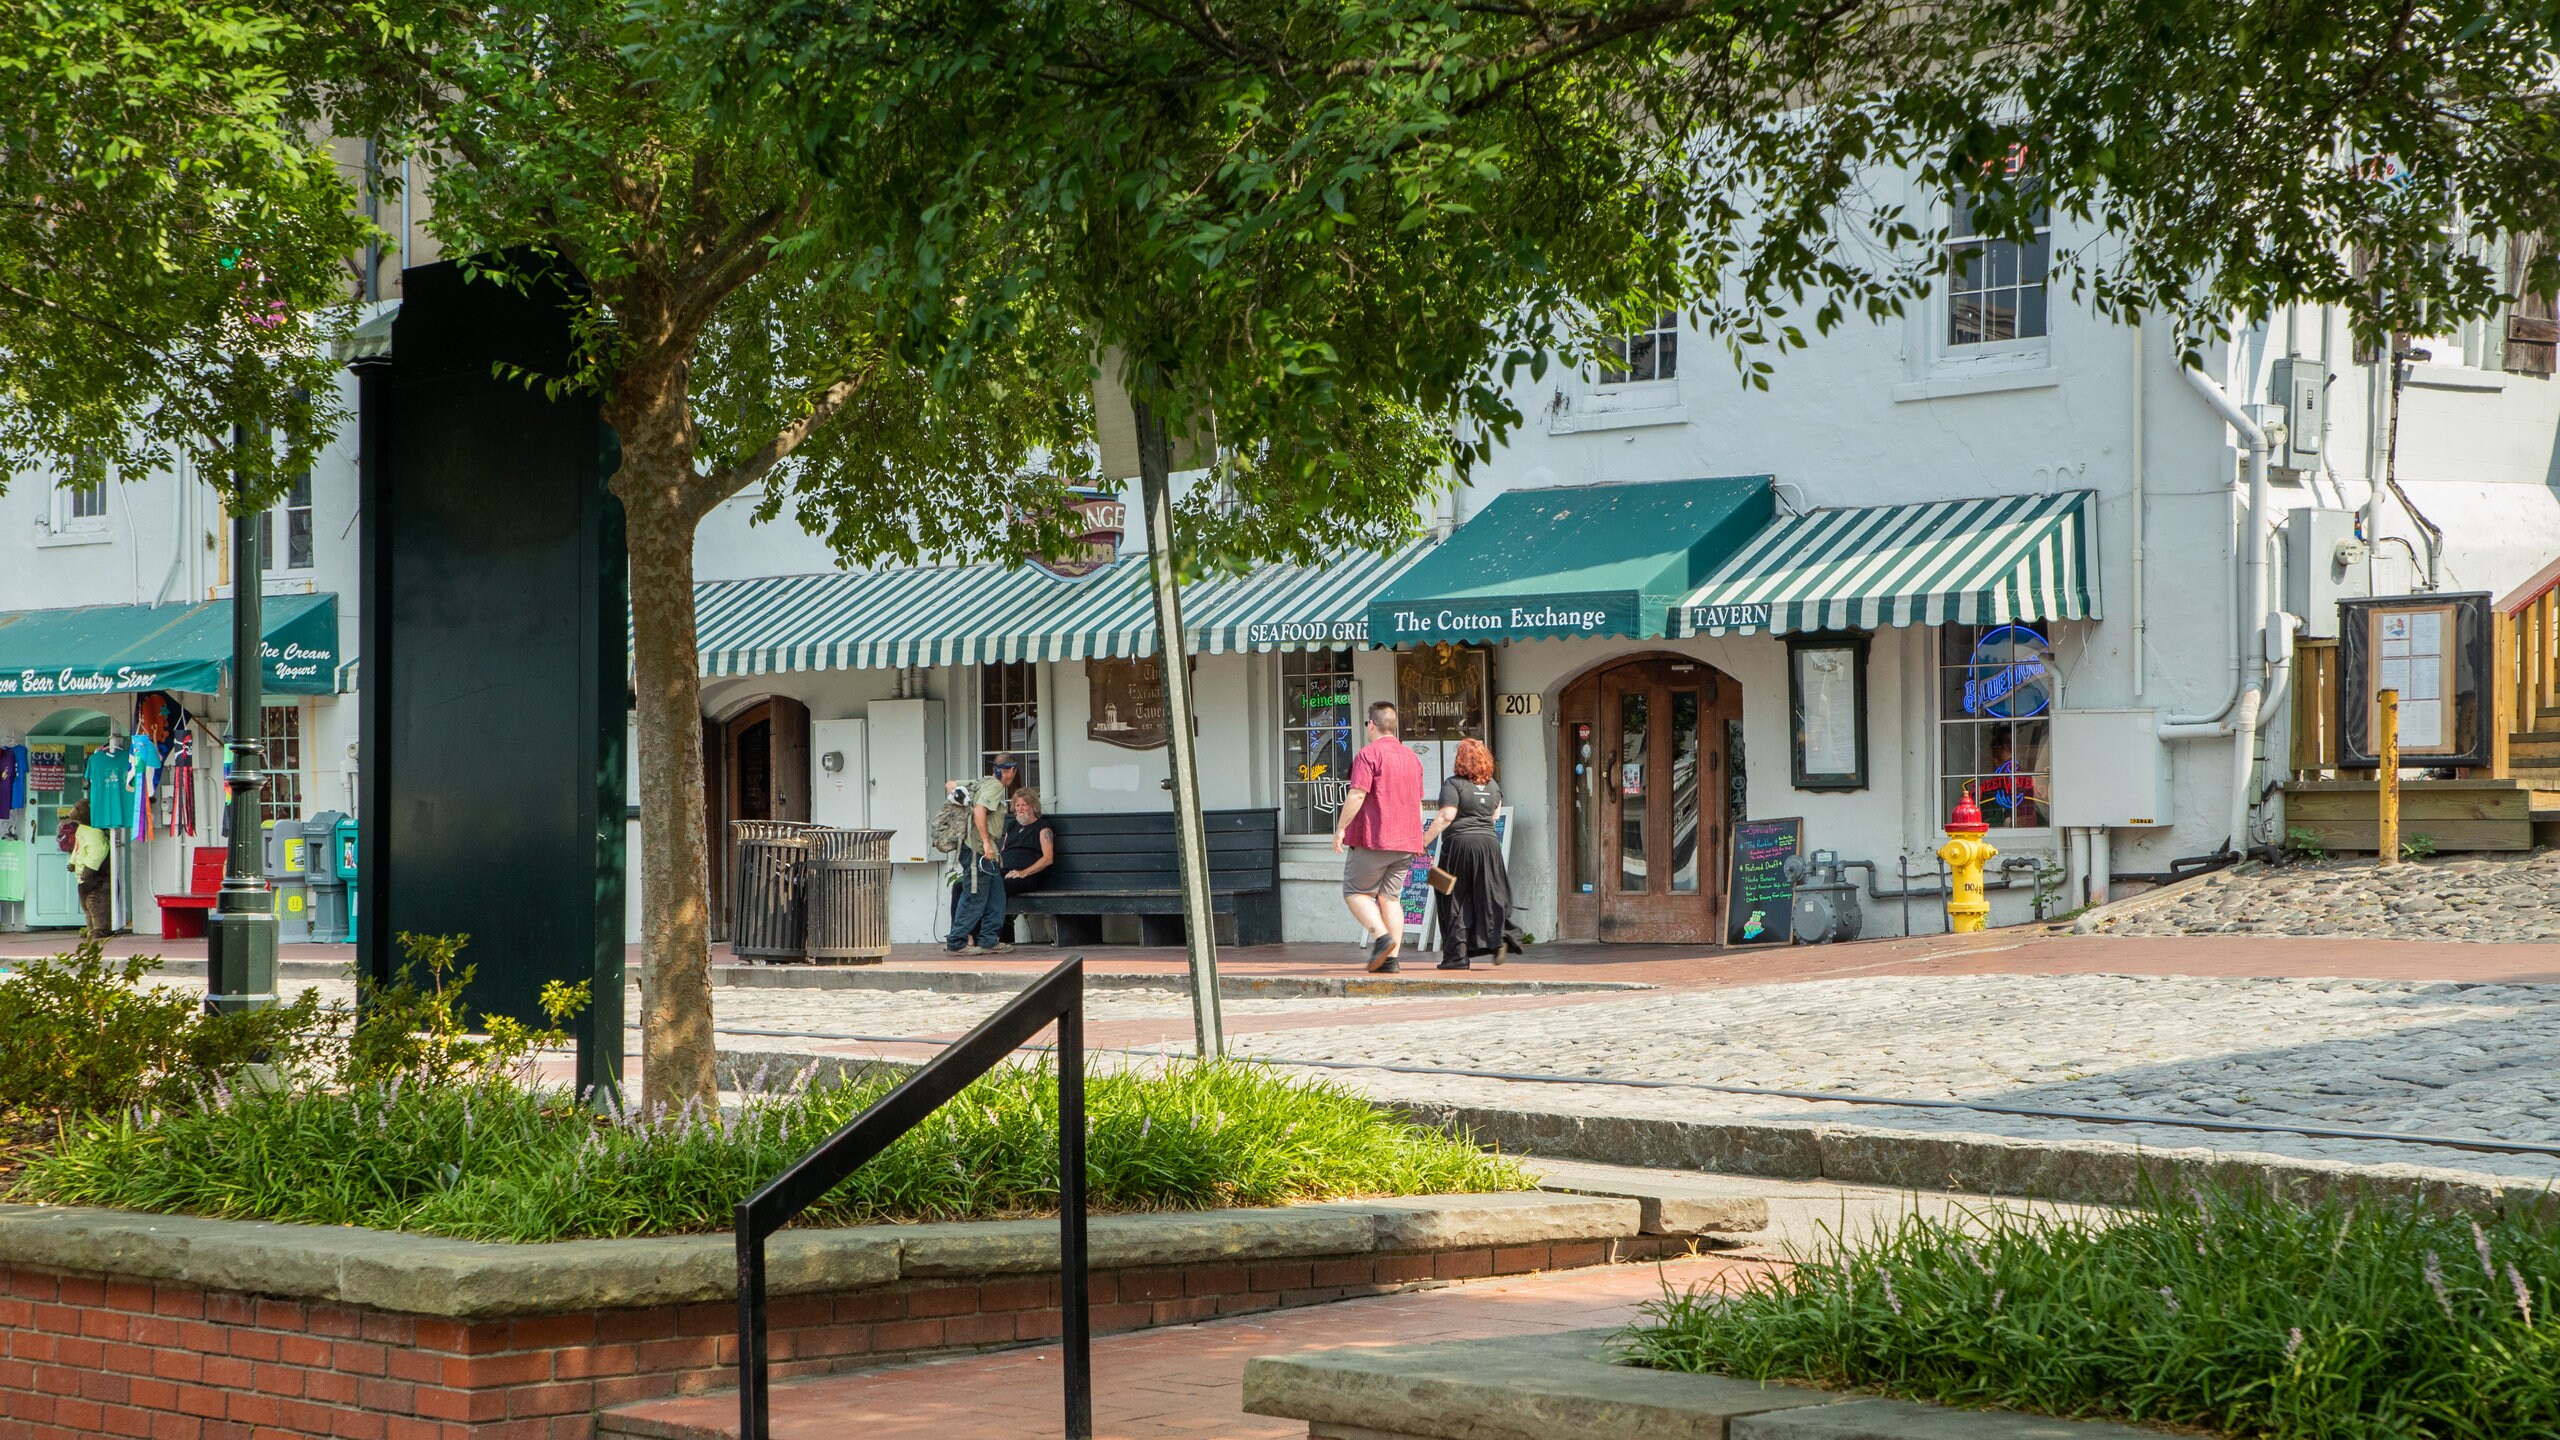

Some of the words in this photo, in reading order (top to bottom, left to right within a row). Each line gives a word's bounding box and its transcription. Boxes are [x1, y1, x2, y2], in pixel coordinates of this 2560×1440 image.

[1394, 612, 1431, 631] The
[1437, 610, 1502, 630] Cotton
[1510, 606, 1606, 630] Exchange
[1694, 604, 1768, 626] TAVERN
[1250, 622, 1327, 641] SEAFOOD
[260, 642, 279, 657] Ice
[283, 643, 331, 660] Cream
[275, 662, 317, 680] Yogurt
[1143, 664, 1161, 680] Th
[21, 669, 55, 692] Bear
[58, 667, 115, 695] Country
[117, 666, 156, 689] Store
[1418, 701, 1463, 717] RESTAURANT
[1505, 695, 1531, 714] 201
[1749, 824, 1775, 838] Specials
